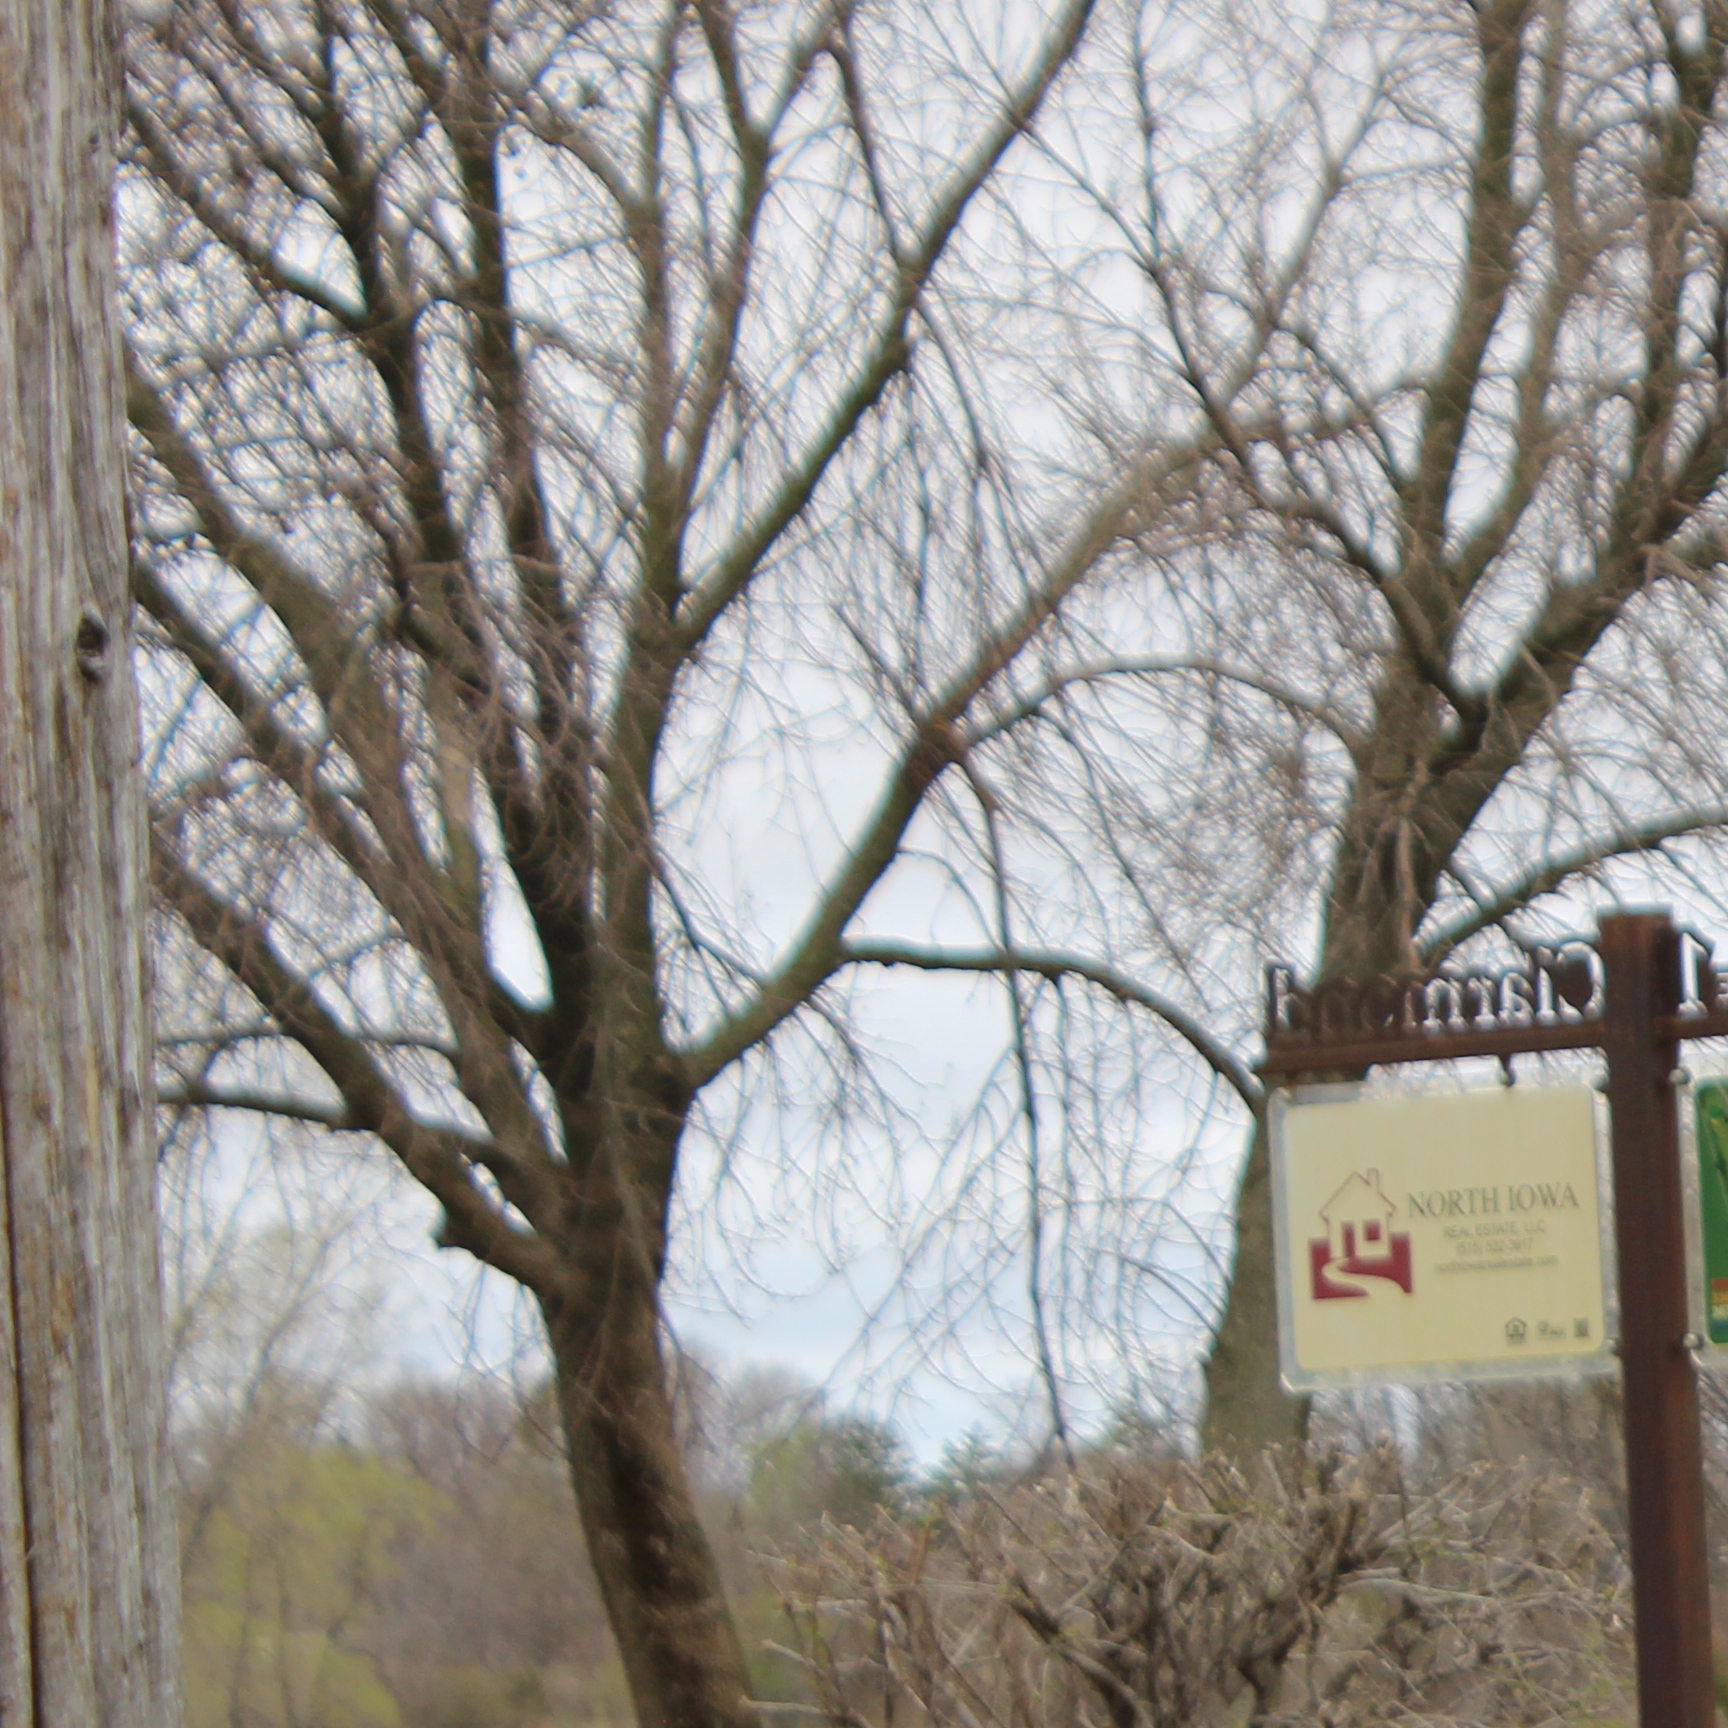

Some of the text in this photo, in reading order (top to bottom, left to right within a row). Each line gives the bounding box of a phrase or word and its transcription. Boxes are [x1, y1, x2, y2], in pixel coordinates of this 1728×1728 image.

[1407, 1181, 1581, 1218] NORTH IOWA
[1444, 1224, 1473, 1238] REAL
[1524, 1219, 1546, 1234] LLC
